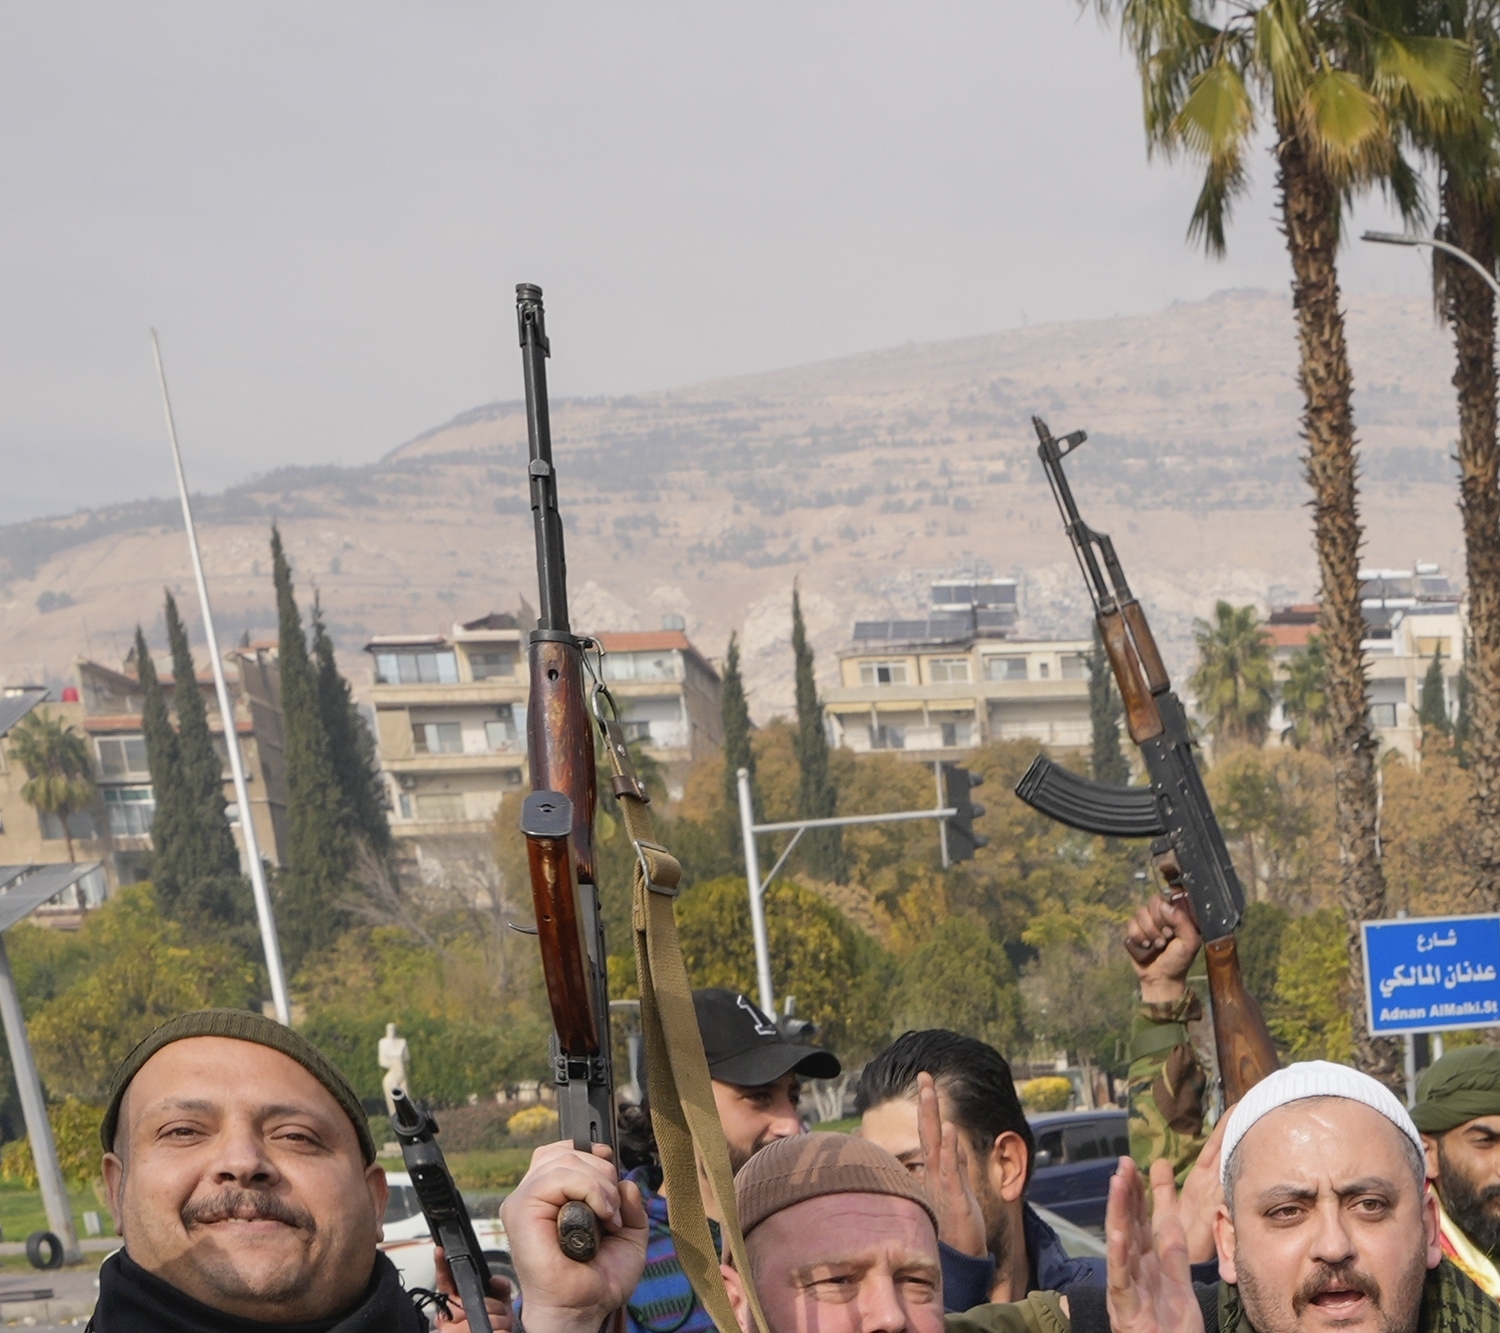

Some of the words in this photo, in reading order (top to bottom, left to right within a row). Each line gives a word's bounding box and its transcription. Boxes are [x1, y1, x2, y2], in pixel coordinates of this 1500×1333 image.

[1416, 929, 1457, 952] شارع
[1379, 963, 1441, 998] المالكي
[1444, 960, 1496, 989] عدنان
[1380, 1006, 1426, 1022] Adnan
